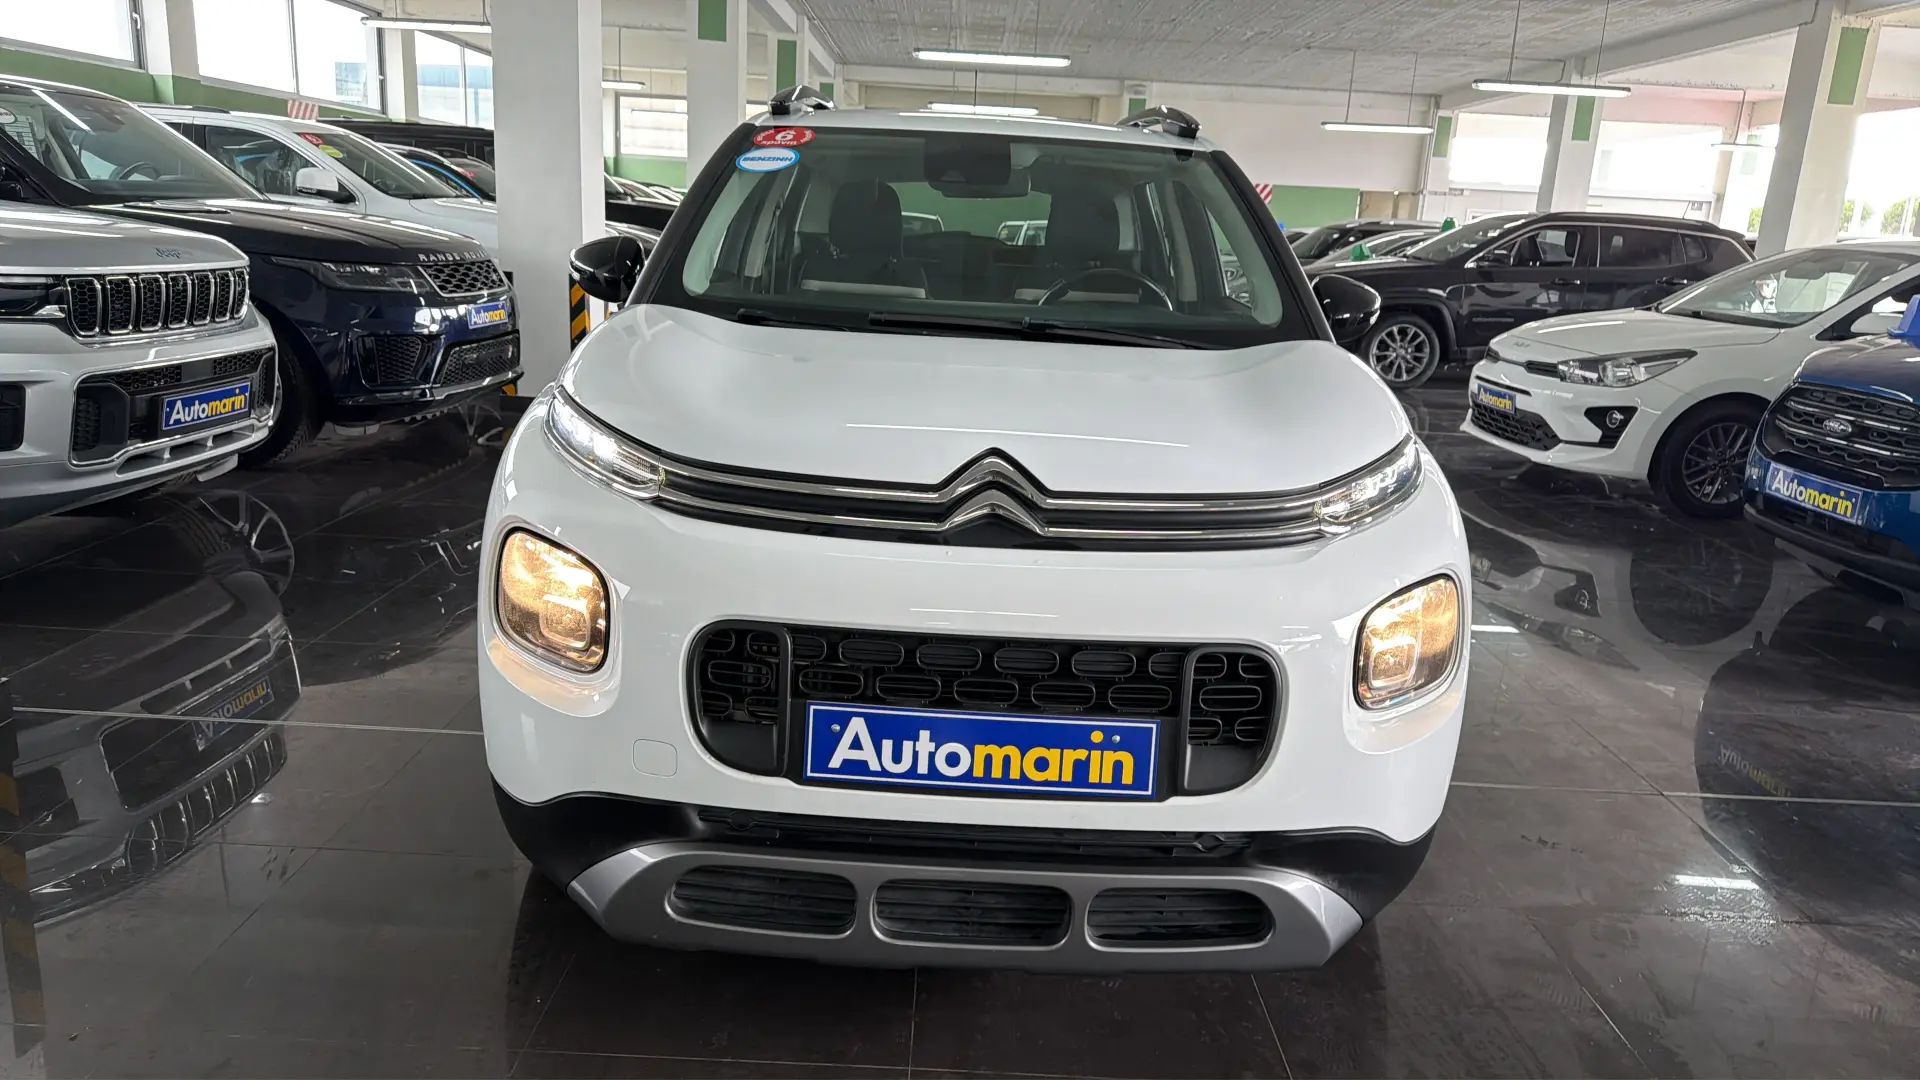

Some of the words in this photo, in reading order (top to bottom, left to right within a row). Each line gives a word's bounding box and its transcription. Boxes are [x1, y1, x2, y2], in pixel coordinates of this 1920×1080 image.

[775, 131, 796, 141] 6
[418, 252, 461, 262] RANGE
[470, 303, 506, 325] Automarin
[169, 388, 246, 425] Automarin
[1771, 470, 1853, 518] Automarin
[828, 717, 1134, 785] Automarin
